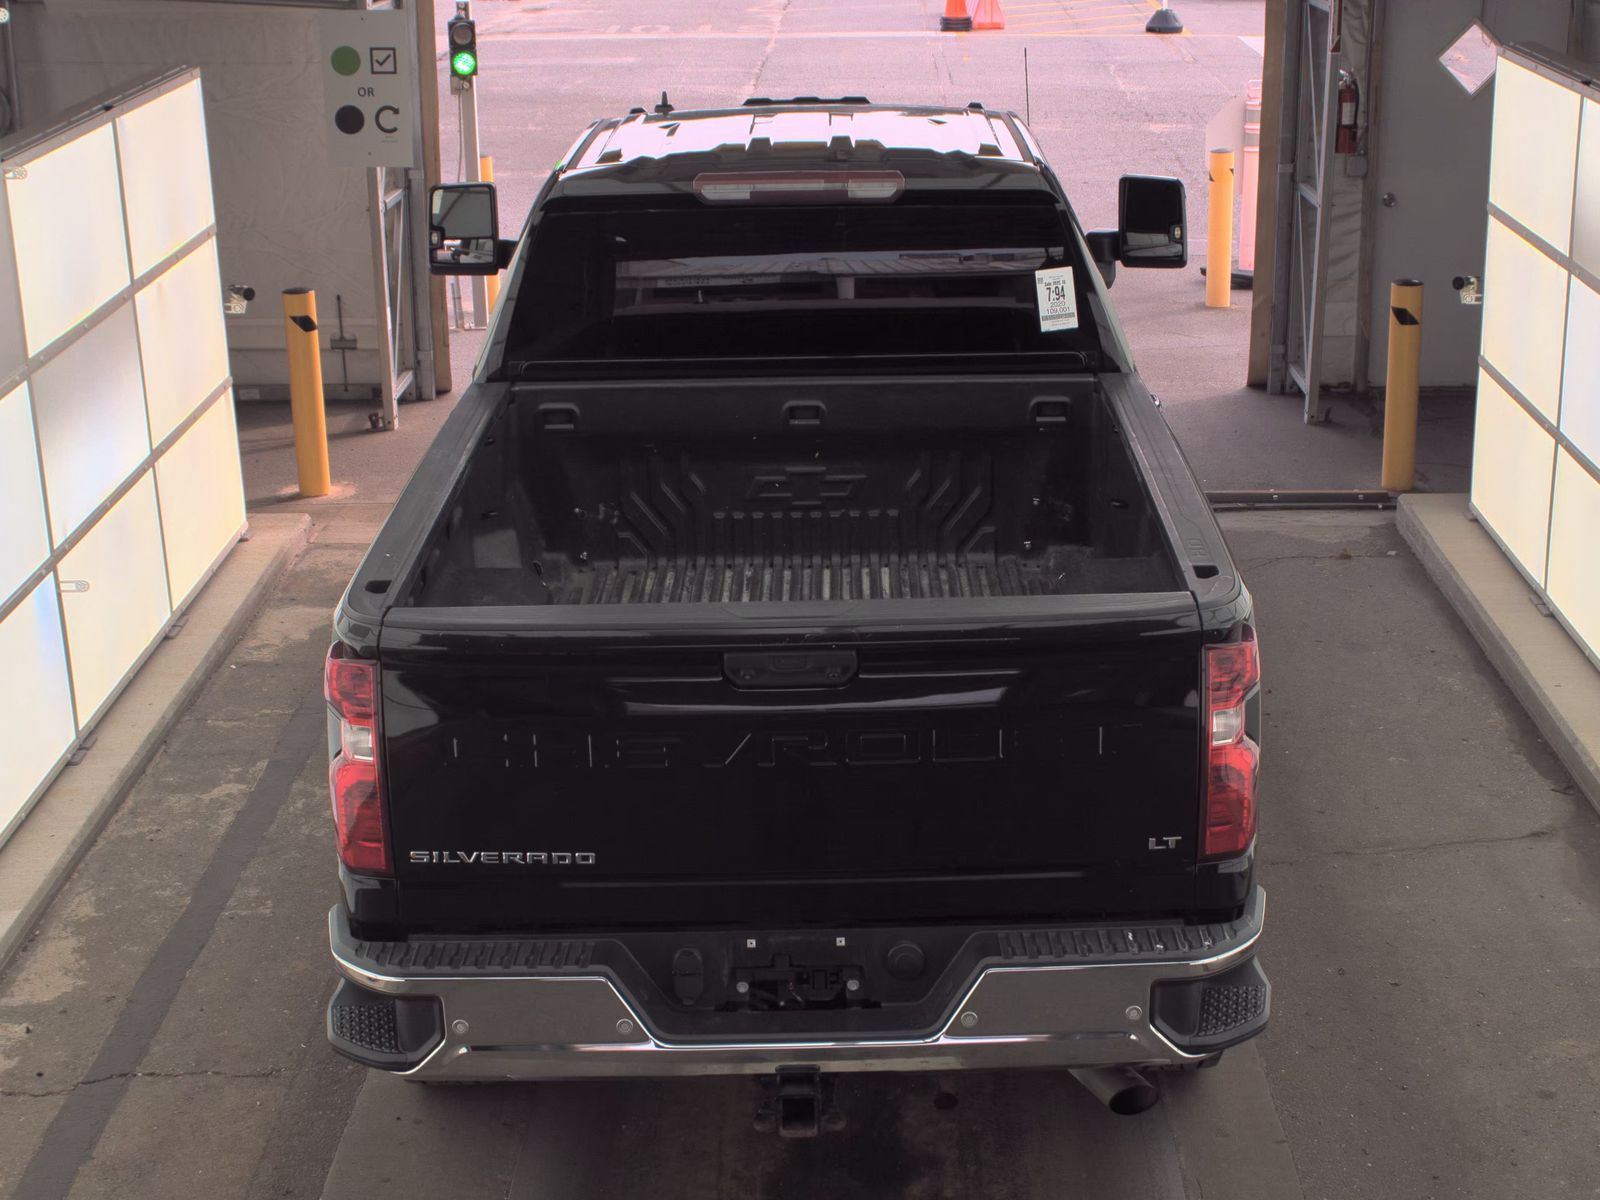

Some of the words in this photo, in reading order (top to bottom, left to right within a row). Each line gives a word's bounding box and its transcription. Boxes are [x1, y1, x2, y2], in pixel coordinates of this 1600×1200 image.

[358, 86, 375, 97] OR
[1148, 836, 1183, 850] LT
[409, 850, 596, 865] SILVERADO
